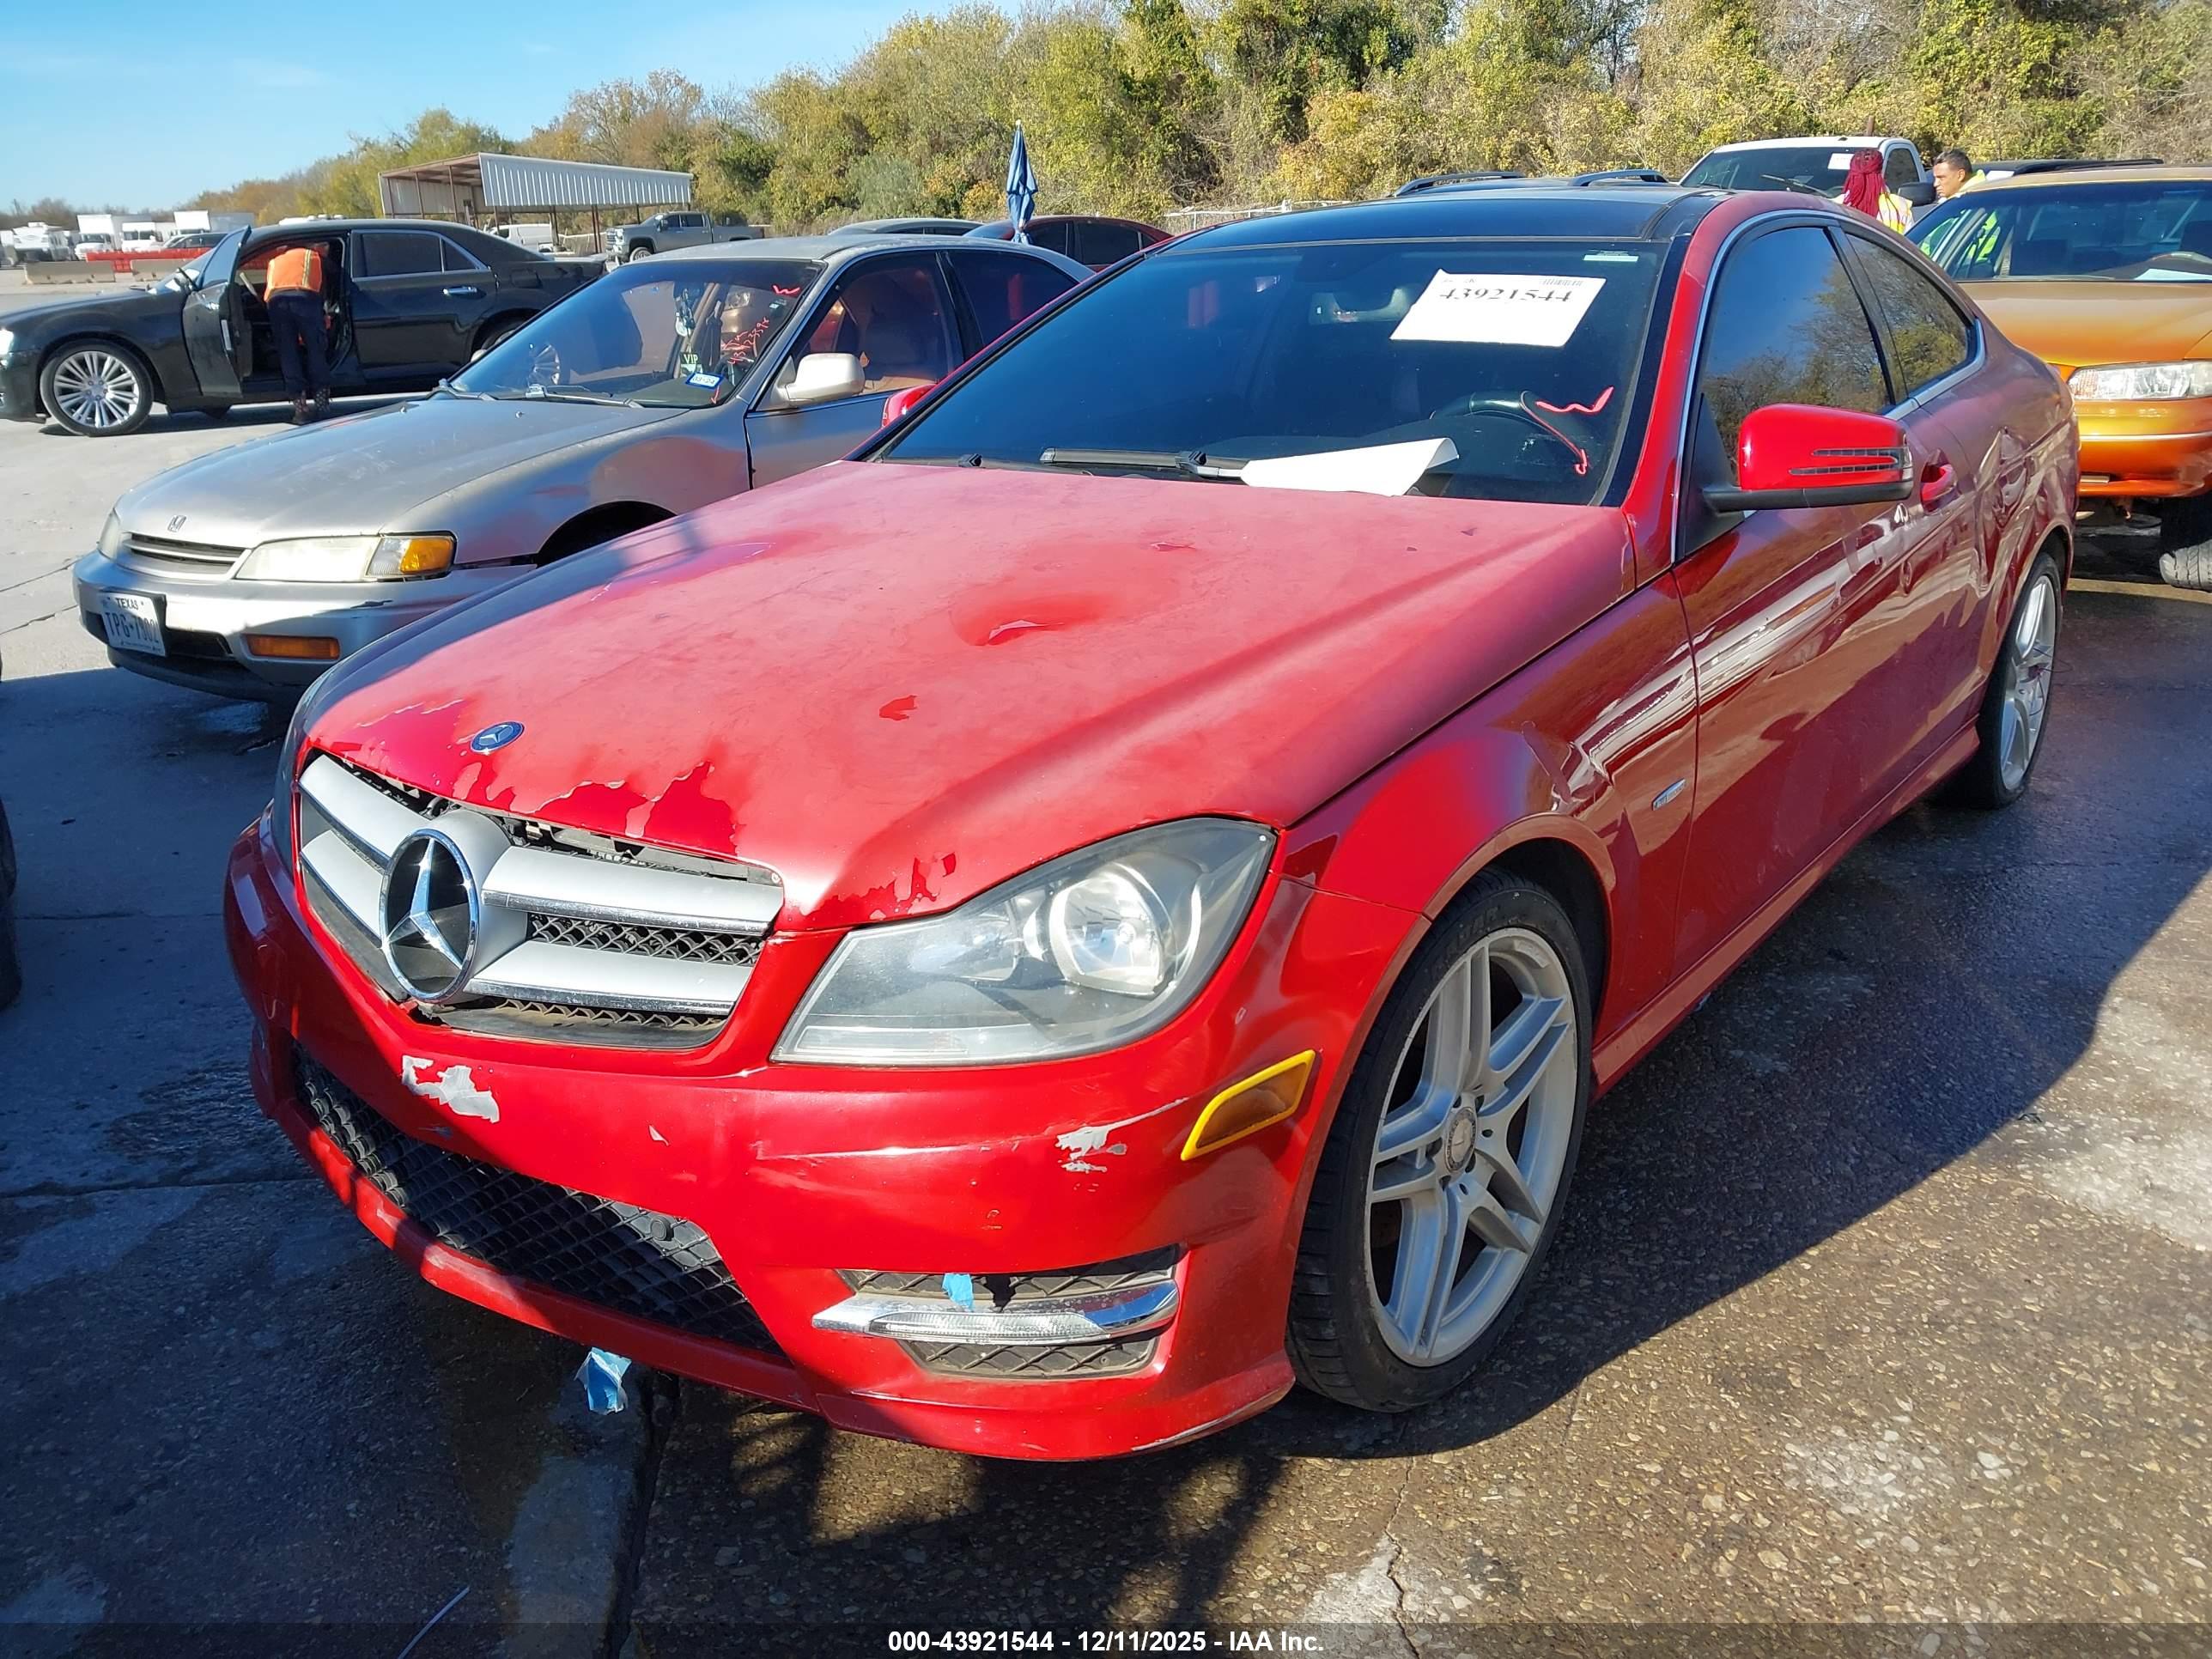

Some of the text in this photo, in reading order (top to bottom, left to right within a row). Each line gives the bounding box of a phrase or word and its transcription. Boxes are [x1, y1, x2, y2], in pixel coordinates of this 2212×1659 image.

[1439, 288, 1572, 302] 43921544
[683, 353, 699, 364] VIP
[115, 597, 139, 611] TEXAS
